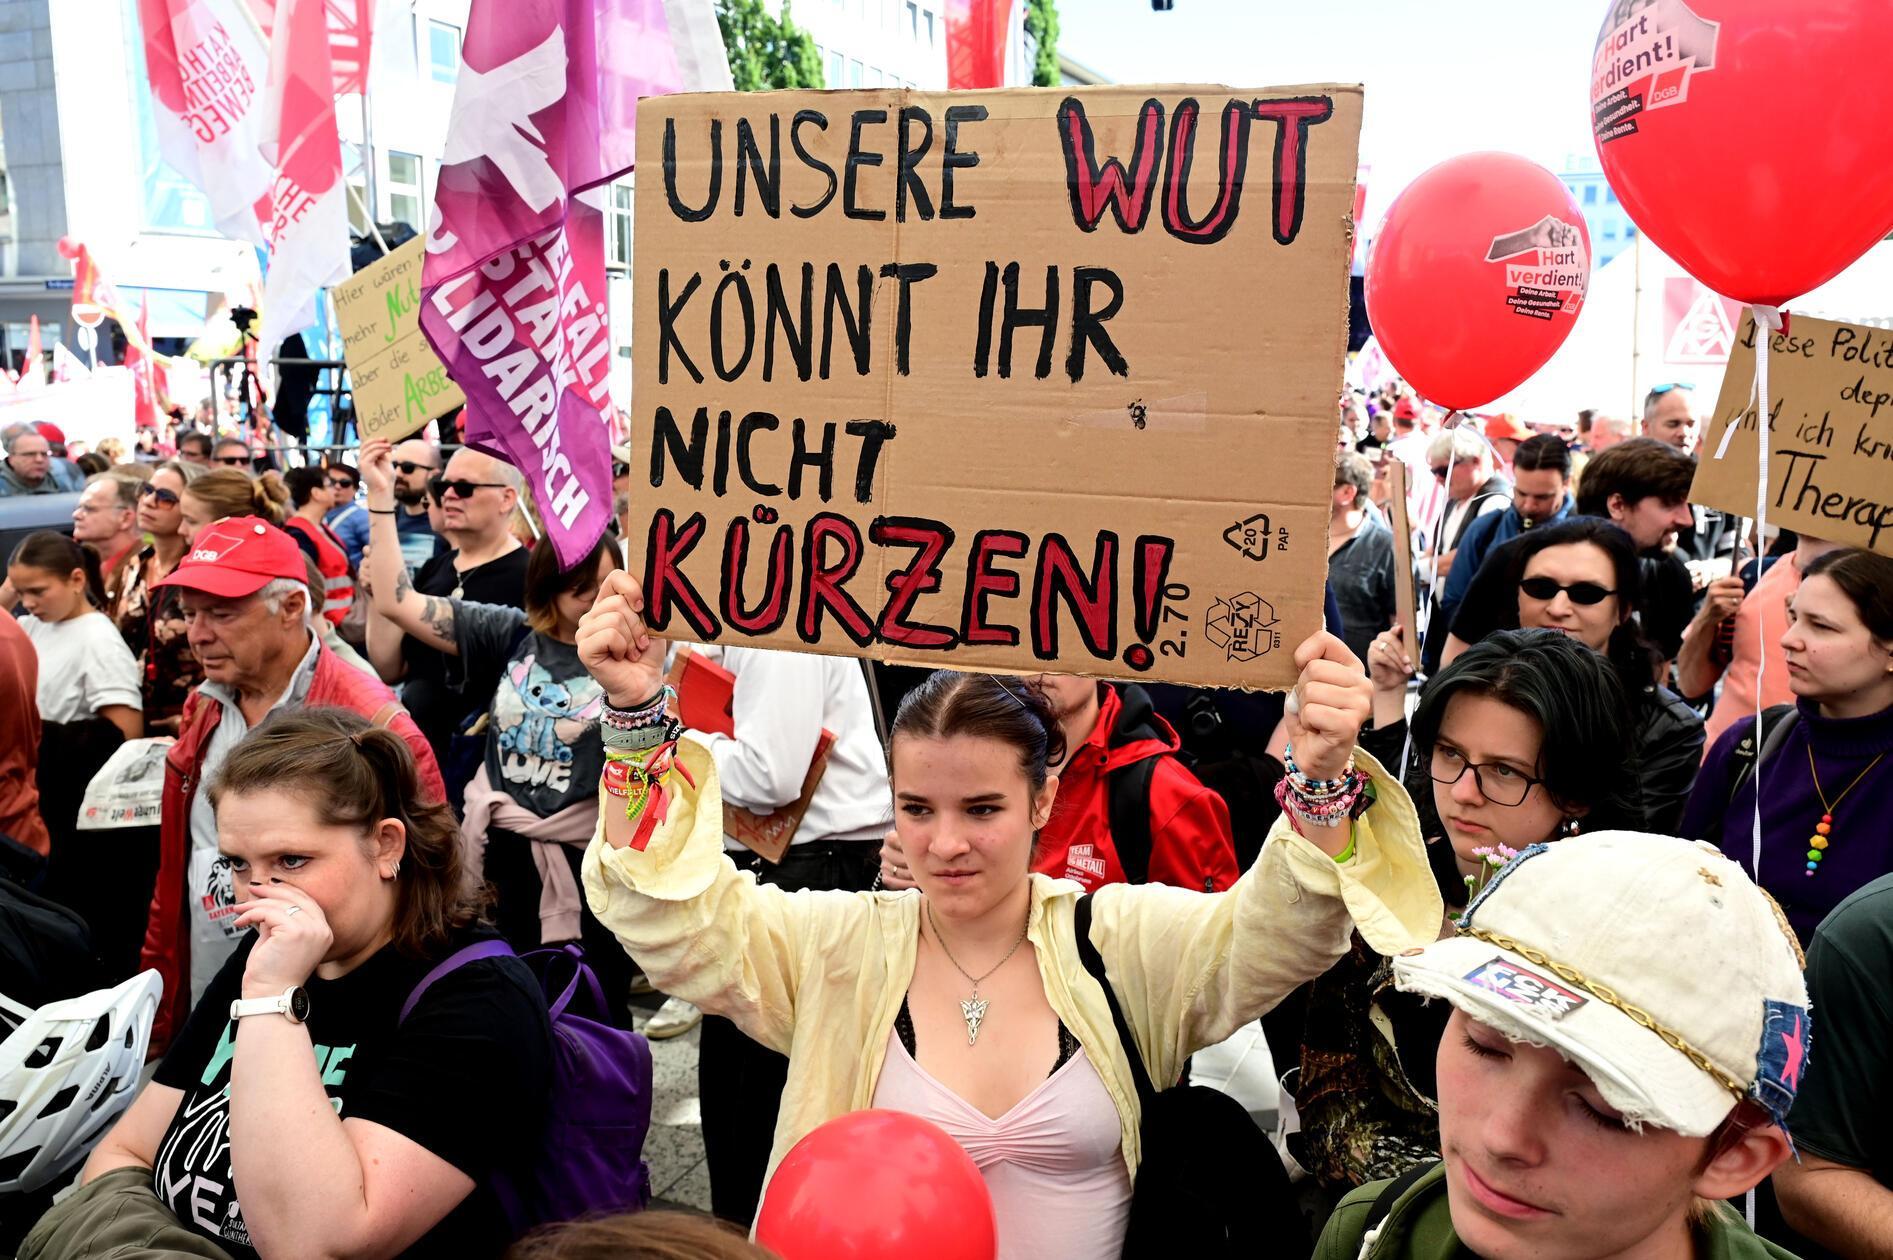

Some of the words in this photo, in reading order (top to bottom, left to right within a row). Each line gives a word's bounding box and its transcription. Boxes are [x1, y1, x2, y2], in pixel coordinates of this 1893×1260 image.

[1604, 15, 1648, 57] Hart
[1653, 86, 1678, 101] DGB
[662, 105, 990, 224] UNSERE
[1057, 95, 1333, 246] WUT
[1542, 250, 1575, 266] Hart
[334, 284, 364, 311] Hier
[1510, 269, 1583, 287] verdient!
[343, 321, 378, 349] mehr
[657, 259, 938, 384] KÖNNT
[974, 260, 1131, 384] IHR
[353, 366, 379, 391] aber
[390, 349, 410, 370] die
[404, 365, 453, 424] ARBE
[1796, 410, 1834, 448] ich
[648, 406, 897, 503] NICHT
[193, 550, 218, 562] DGB
[1243, 528, 1258, 547] 20
[1277, 527, 1290, 551] PAP
[643, 505, 1175, 671] KÜRZEN!
[1159, 582, 1191, 659] 2.70
[1231, 600, 1253, 653] RESY
[608, 785, 642, 796] VIELFLT
[1071, 846, 1091, 857] TEAM
[84, 1061, 111, 1101] ALPINA
